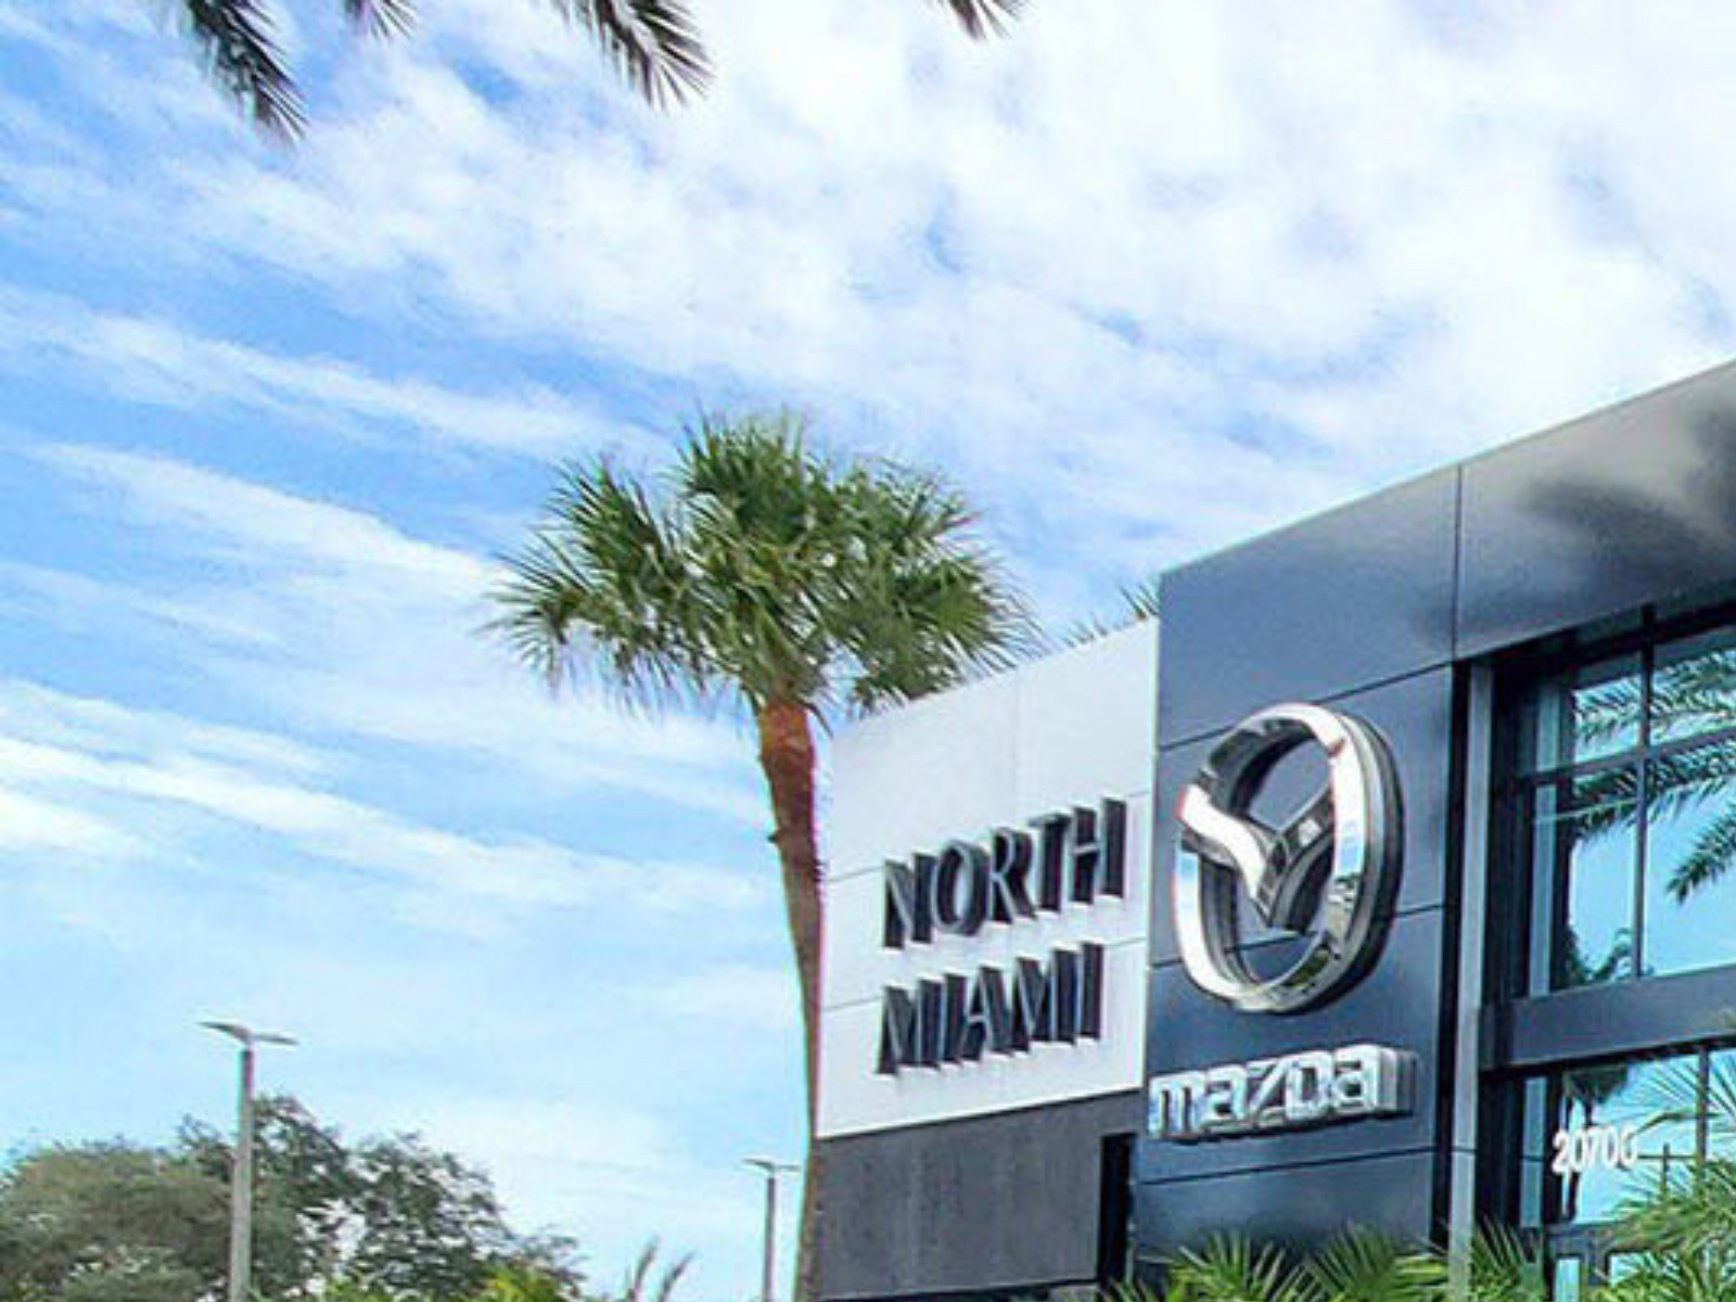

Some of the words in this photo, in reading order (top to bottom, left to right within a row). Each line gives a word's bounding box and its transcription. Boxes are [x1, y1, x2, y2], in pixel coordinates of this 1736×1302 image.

[882, 797, 1128, 949] NORTH
[876, 943, 1105, 1074] MIAMI
[1149, 1044, 1402, 1141] mazda
